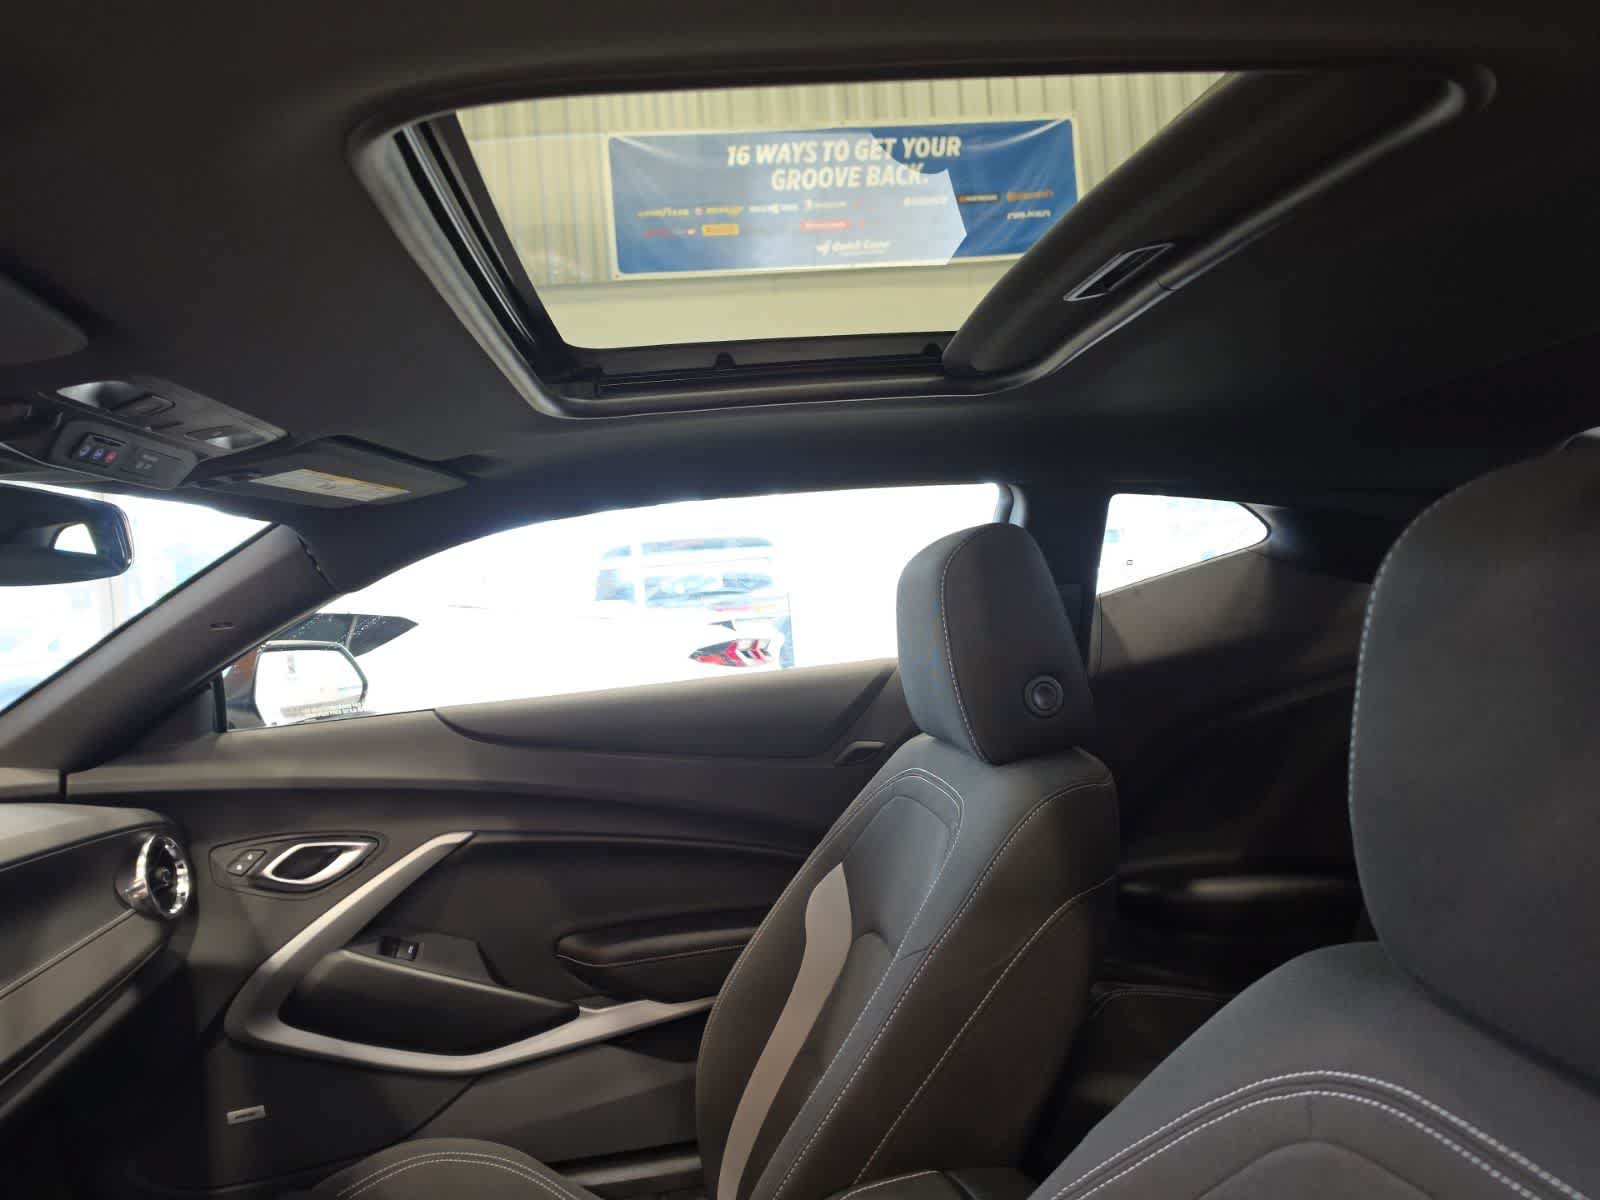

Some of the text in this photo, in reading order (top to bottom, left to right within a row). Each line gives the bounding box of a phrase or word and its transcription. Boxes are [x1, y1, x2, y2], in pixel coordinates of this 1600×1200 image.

[728, 136, 962, 167] 16 WAYS TO GET YOUR
[771, 163, 929, 191] GROOVE BACK.
